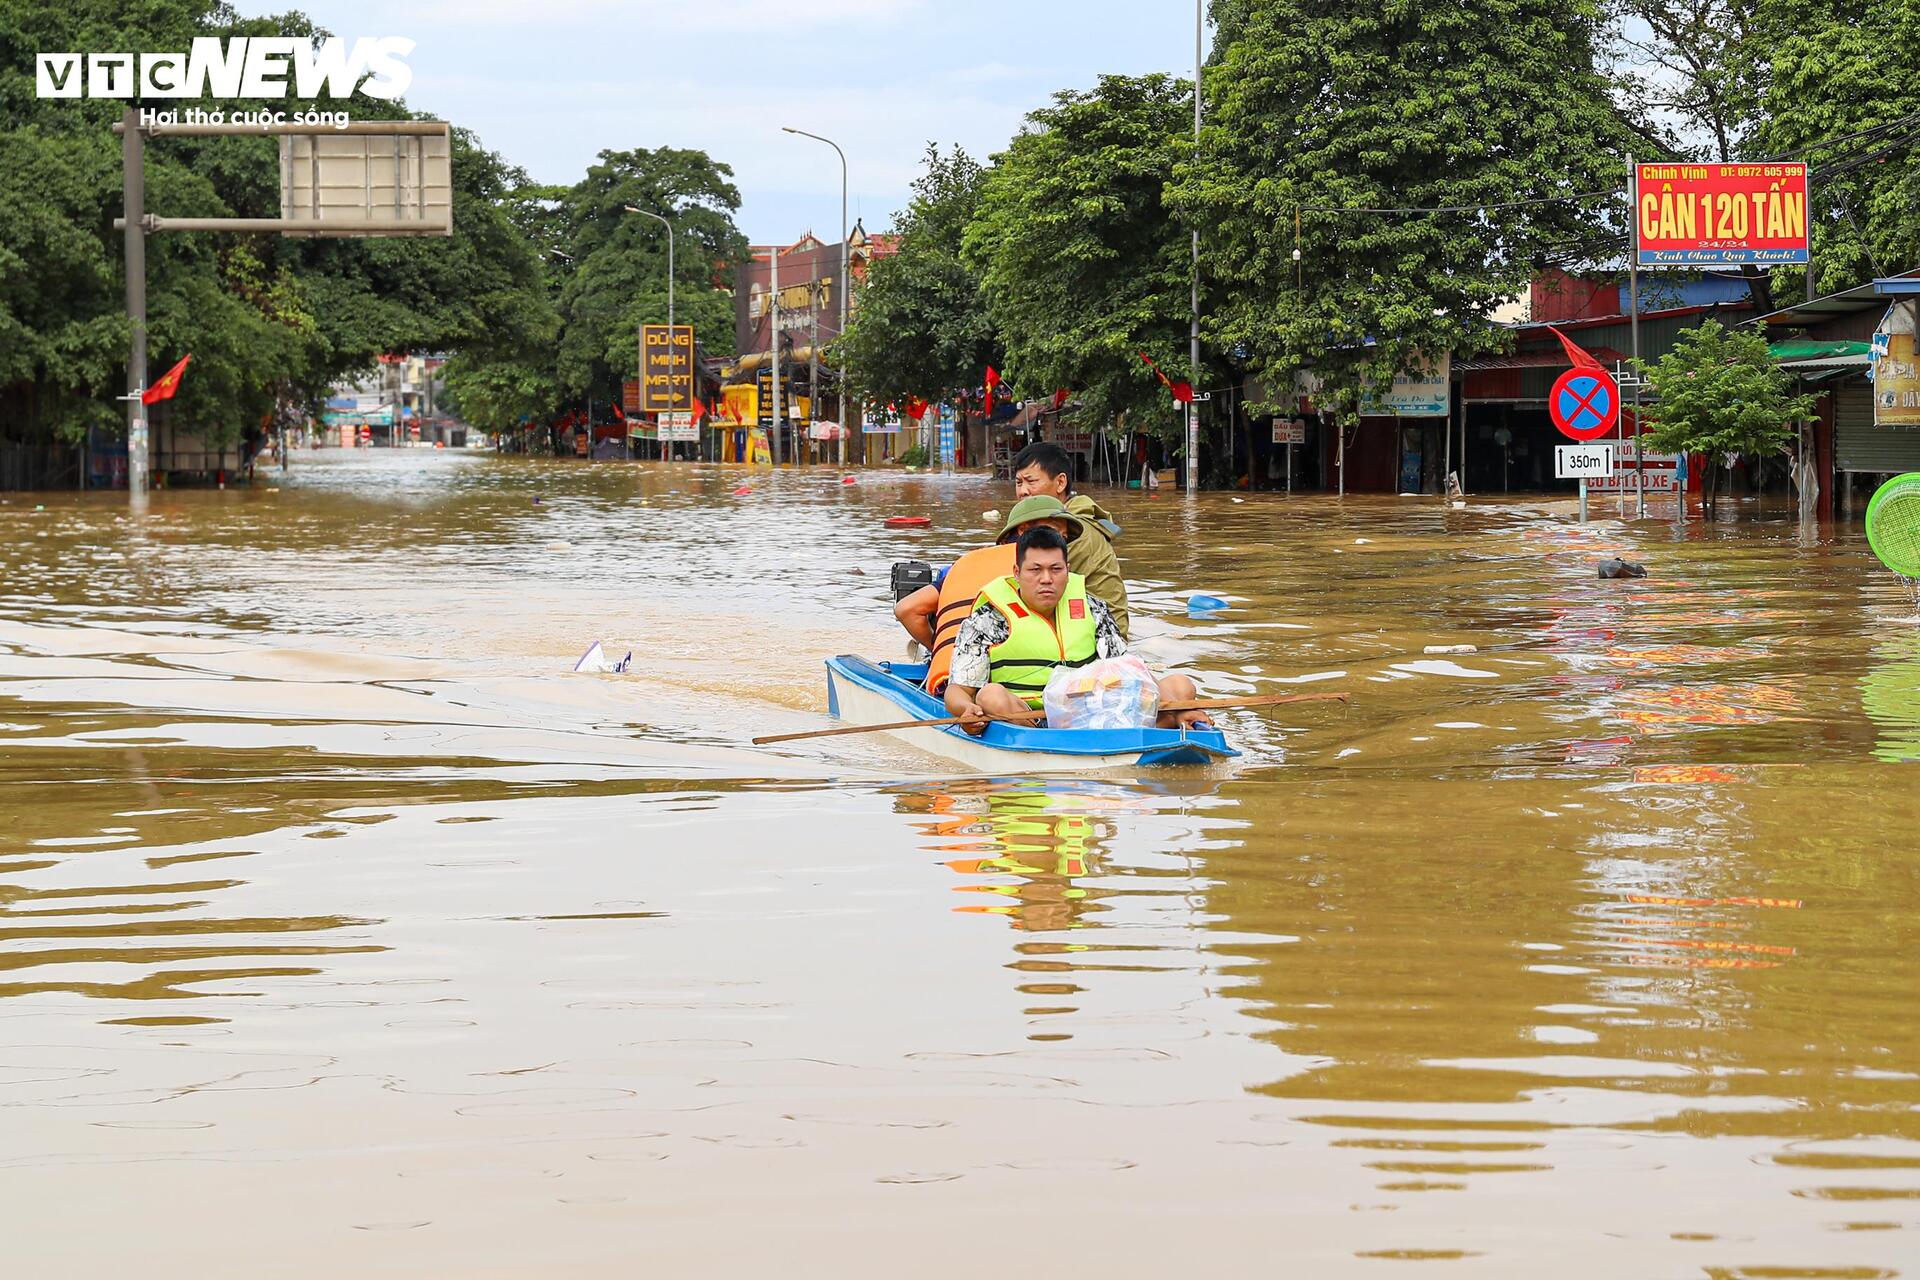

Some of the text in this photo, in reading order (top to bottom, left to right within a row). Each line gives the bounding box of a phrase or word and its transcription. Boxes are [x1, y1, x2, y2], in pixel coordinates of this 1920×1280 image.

[1683, 167, 1708, 183] Vịnh
[1720, 166, 1803, 177] ĐT: 0972 605 999
[1641, 178, 1804, 240] CÂN 120 TẤN
[1698, 240, 1748, 248] 24/24
[647, 332, 689, 346] DŨNG
[651, 354, 686, 366] MINH
[646, 374, 690, 386] MART
[1569, 455, 1601, 469] 350m
[1653, 475, 1668, 487] XE
